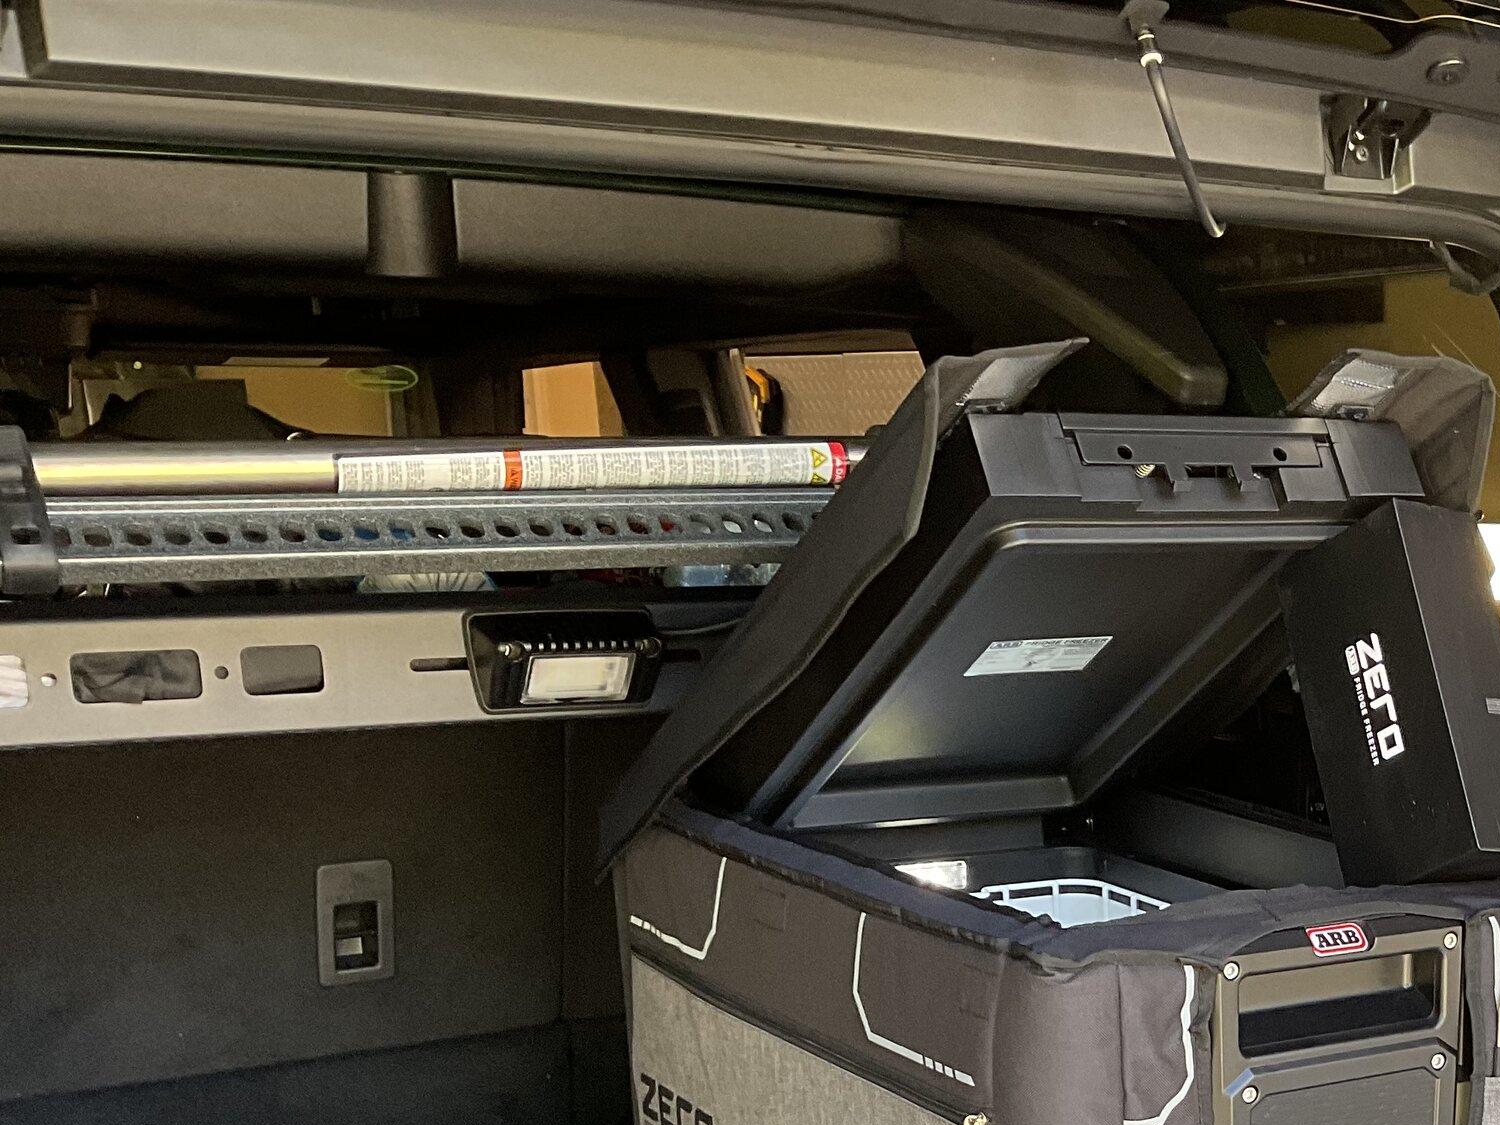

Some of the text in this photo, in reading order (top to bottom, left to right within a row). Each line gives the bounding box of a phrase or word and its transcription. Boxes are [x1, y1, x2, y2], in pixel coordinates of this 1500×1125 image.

[1353, 676, 1369, 716] FRIDGE
[1363, 718, 1380, 766] FREEZER
[1315, 930, 1360, 948] ARB
